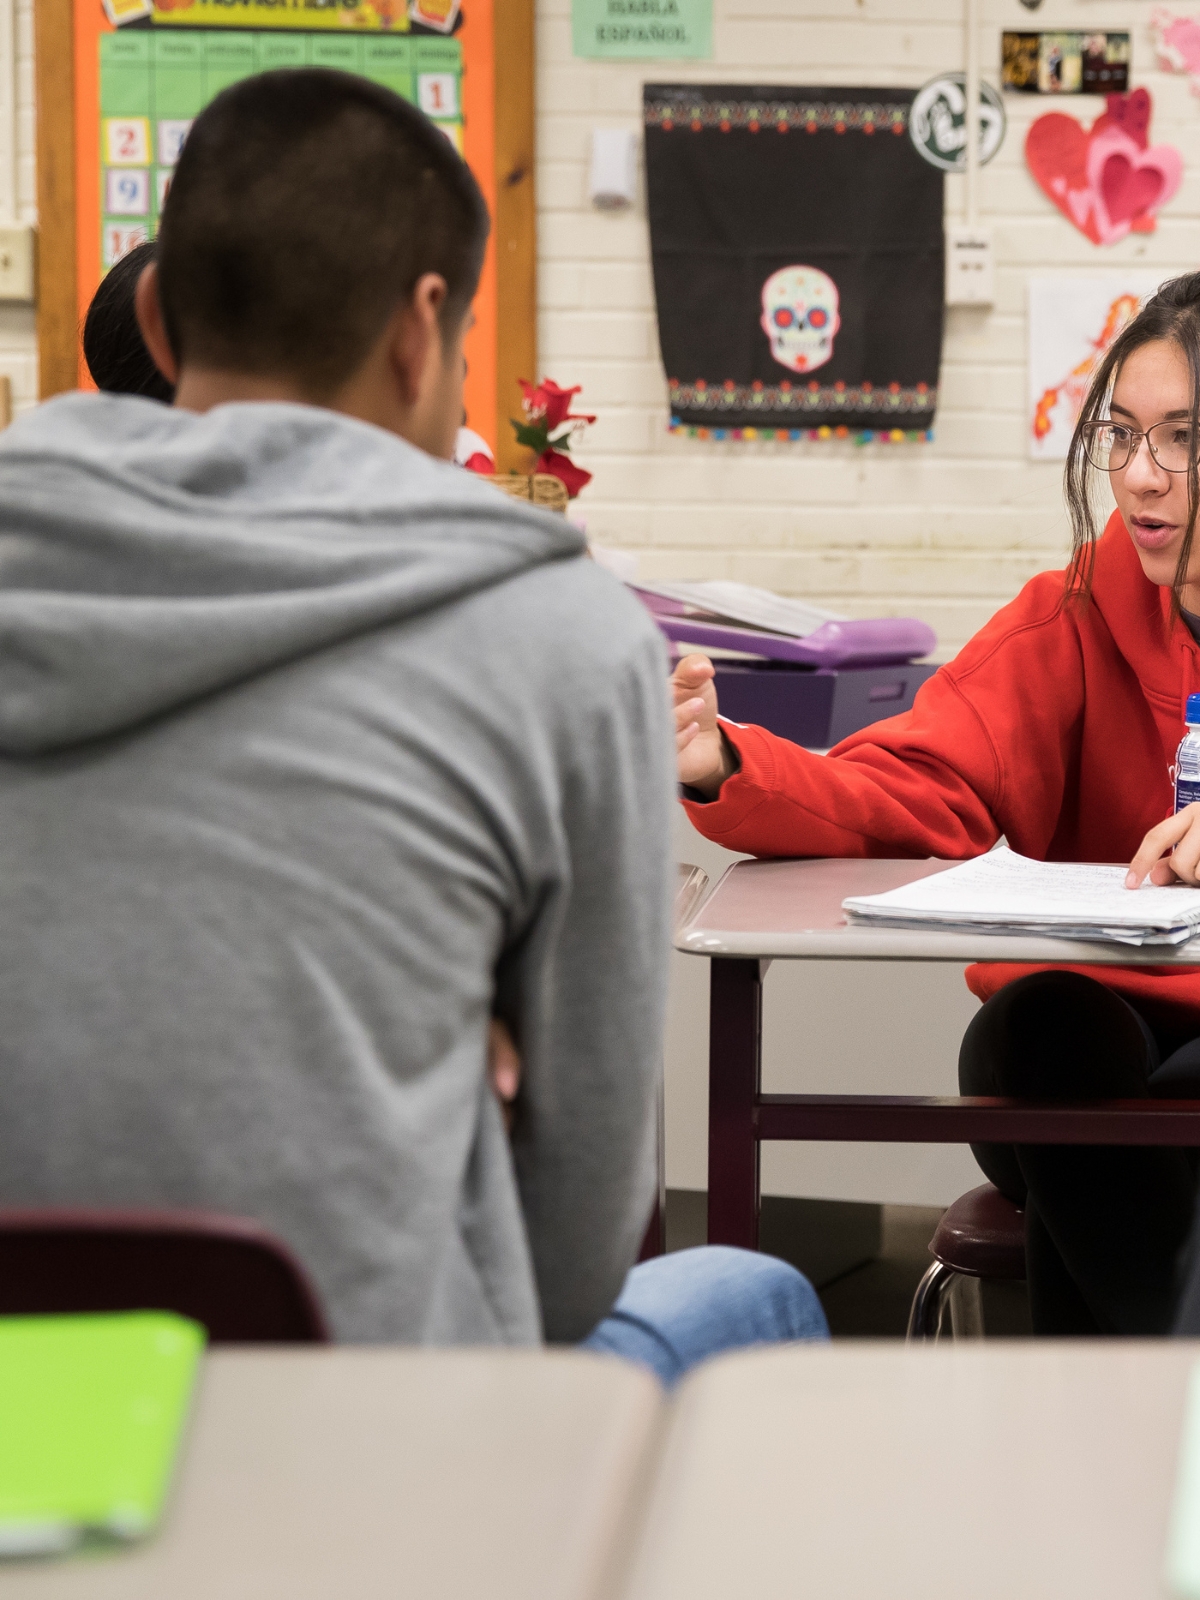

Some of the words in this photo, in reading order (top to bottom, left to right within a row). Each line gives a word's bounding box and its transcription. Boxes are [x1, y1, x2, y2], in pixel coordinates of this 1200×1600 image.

[595, 22, 687, 43] ESPAÑOL
[429, 82, 445, 110] 1
[117, 127, 136, 157] 2
[118, 177, 138, 204] 9
